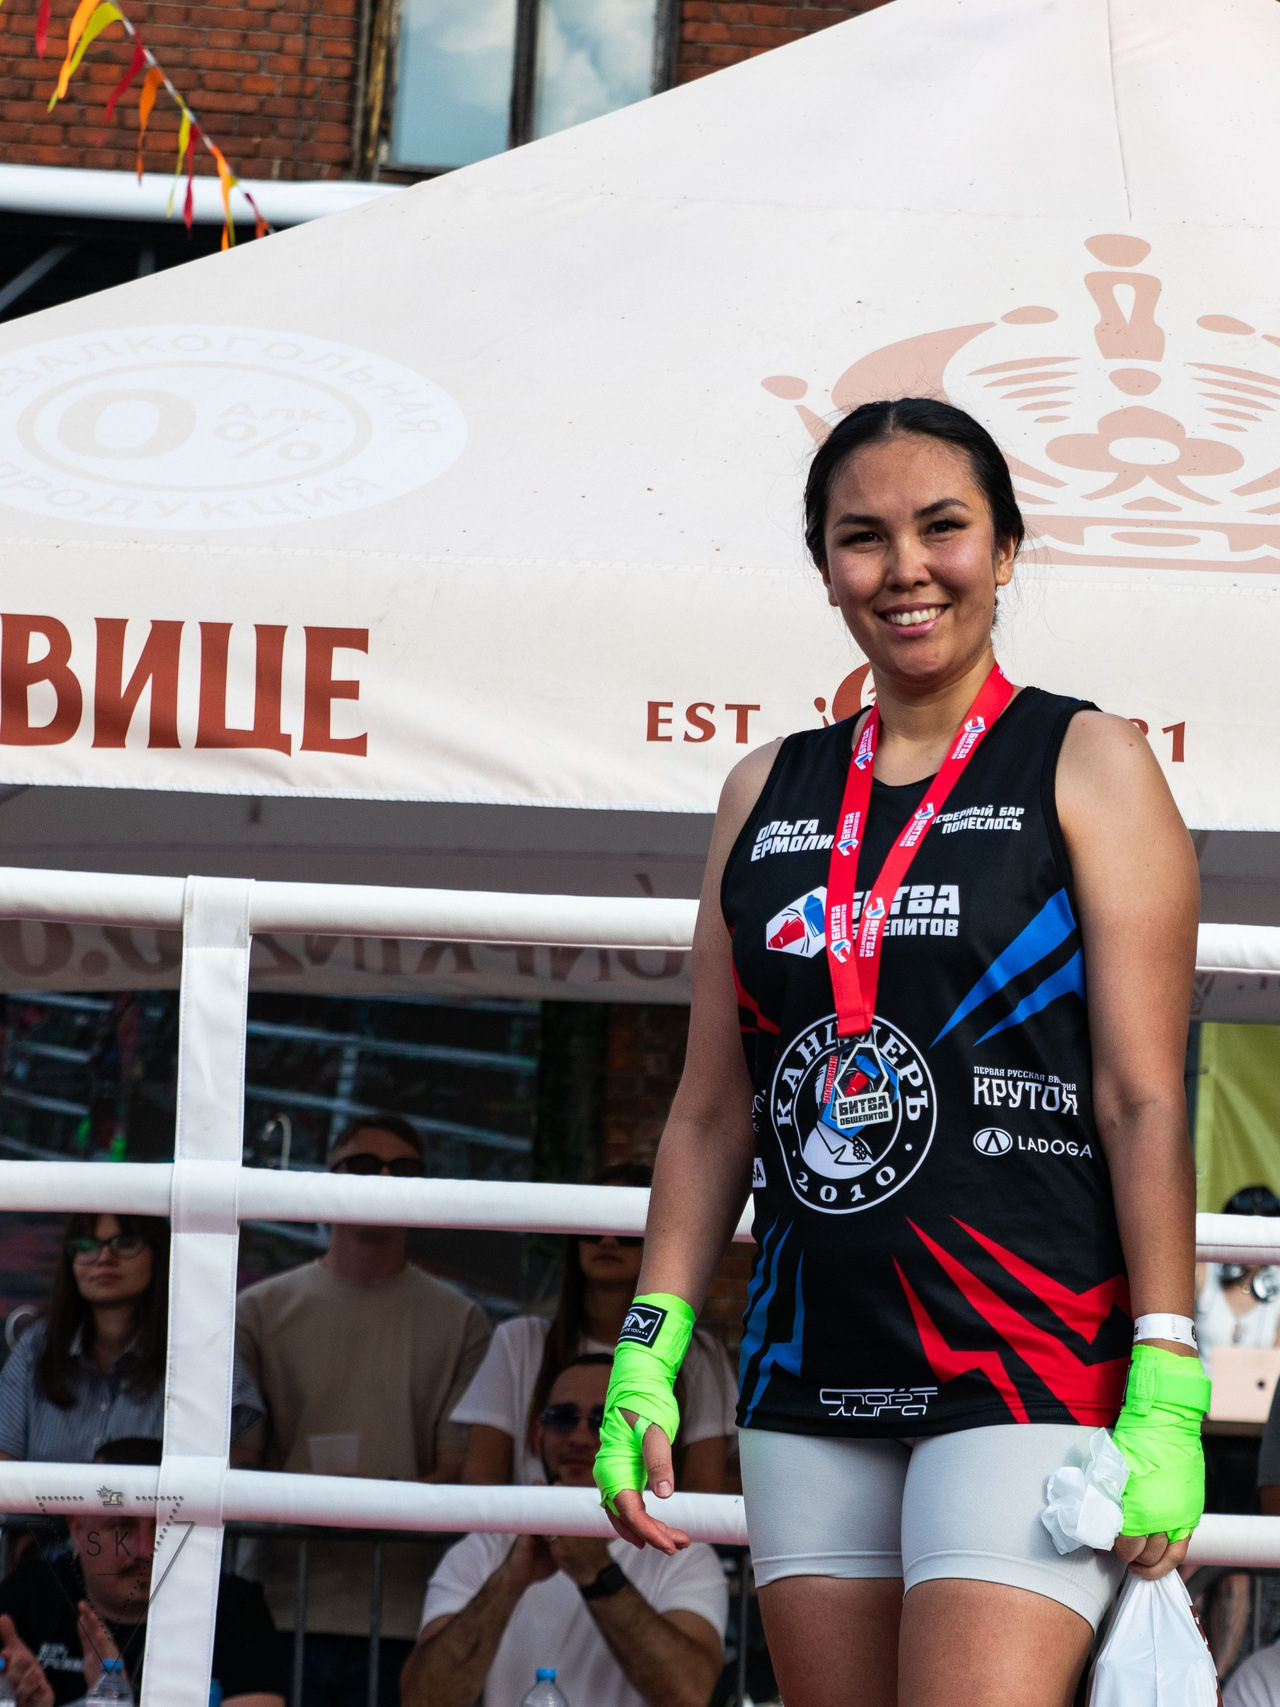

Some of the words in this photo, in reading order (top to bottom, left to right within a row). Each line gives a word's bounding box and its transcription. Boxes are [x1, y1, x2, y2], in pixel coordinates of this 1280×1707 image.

[57, 388, 198, 460] 0
[0, 613, 370, 757] ВИЦЕ
[645, 701, 761, 744] EST
[999, 806, 1025, 817] БАР
[756, 819, 819, 843] ОЛЬГА
[942, 817, 1022, 834] ПОНЕСЛОСЬ
[751, 834, 834, 862] ЕРМОЛИ
[973, 1065, 1005, 1077] ПЕРВАЯ
[1007, 1069, 1045, 1082] РУССКАЯ
[838, 1096, 889, 1117] БИТВА
[1018, 1135, 1093, 1159] LADOGA
[796, 1165, 896, 1203] 2010
[820, 1387, 938, 1405] СПОРТ
